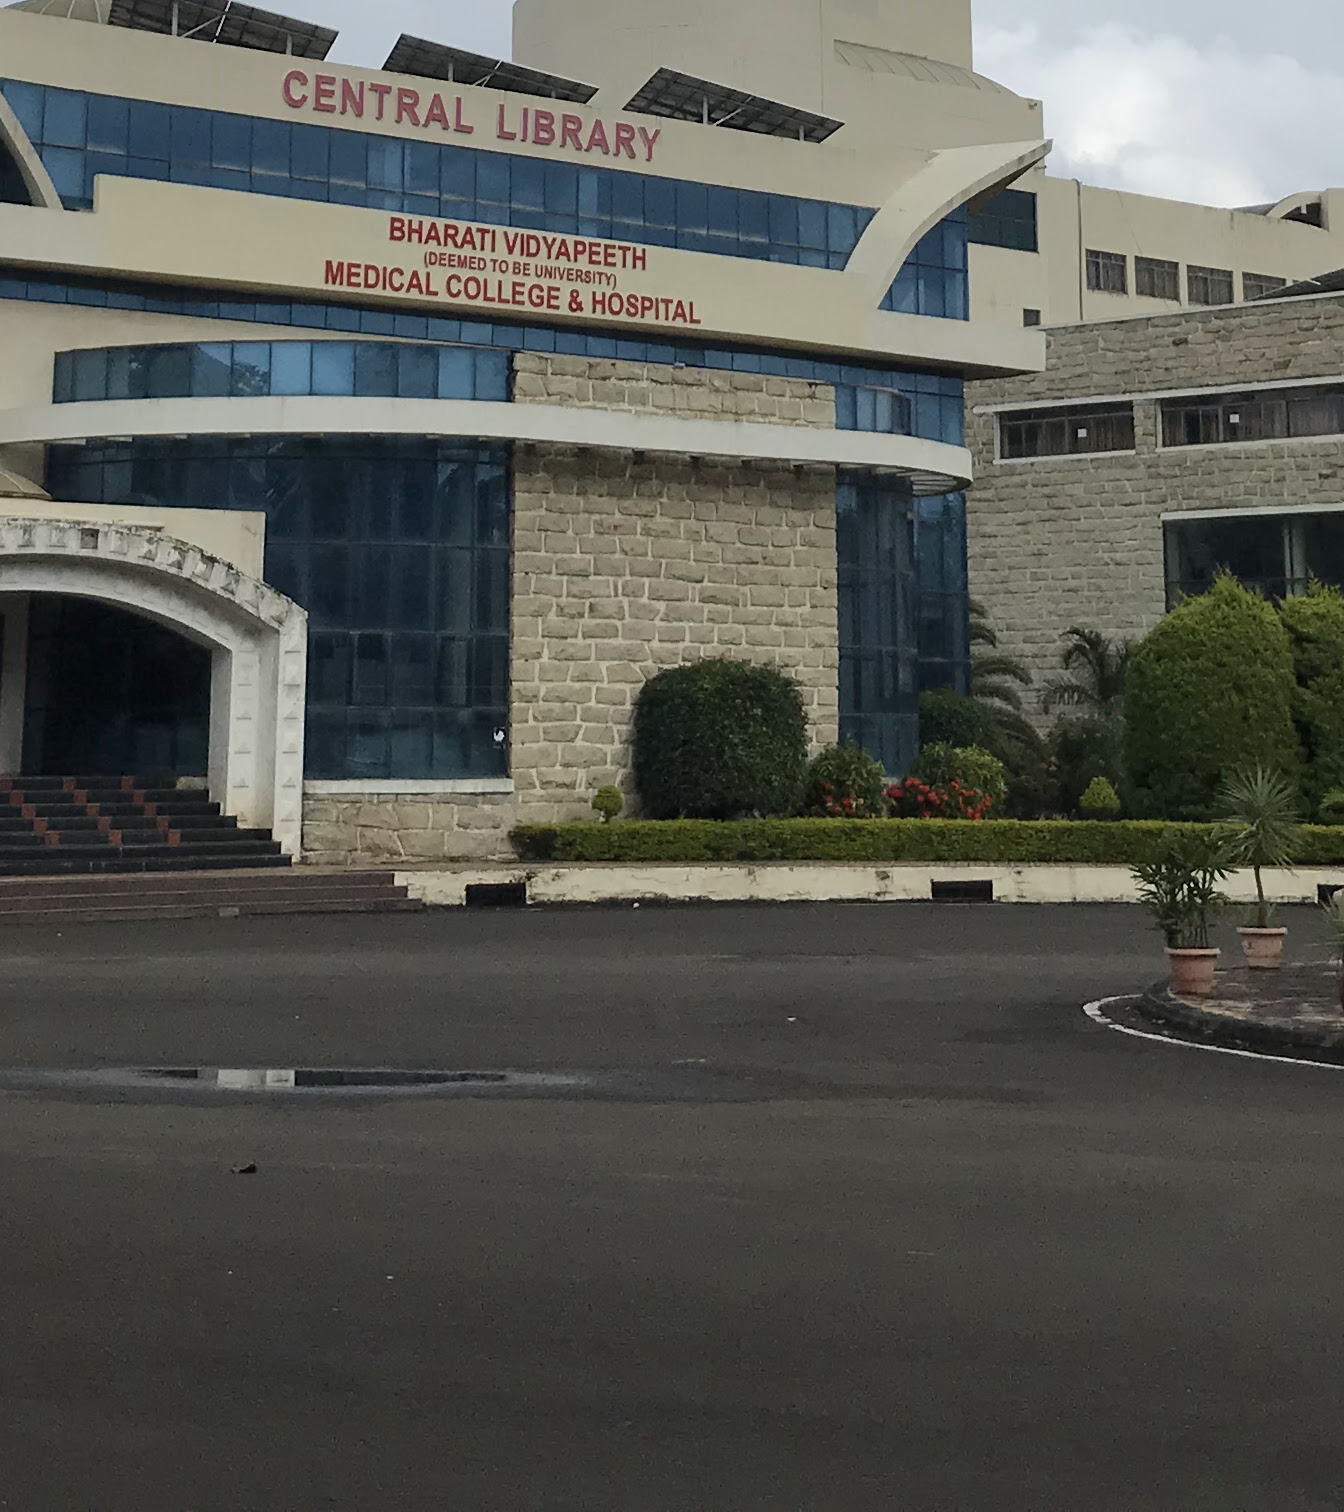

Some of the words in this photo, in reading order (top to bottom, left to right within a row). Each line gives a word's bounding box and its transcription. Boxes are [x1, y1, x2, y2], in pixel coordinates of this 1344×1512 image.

[283, 70, 474, 134] CENTRAL
[497, 103, 661, 161] LIBRARY
[389, 217, 496, 252] BHARATI
[503, 231, 647, 271] VIDYAPEETH
[424, 251, 487, 272] (DEEMED
[490, 258, 509, 274] TO
[511, 261, 531, 276] BE
[534, 264, 617, 290] UNIVERSITY)
[324, 260, 439, 298] MEDICAL
[446, 273, 561, 312] COLLEGE
[567, 289, 584, 313] &
[592, 291, 702, 325] HOSPITAL
